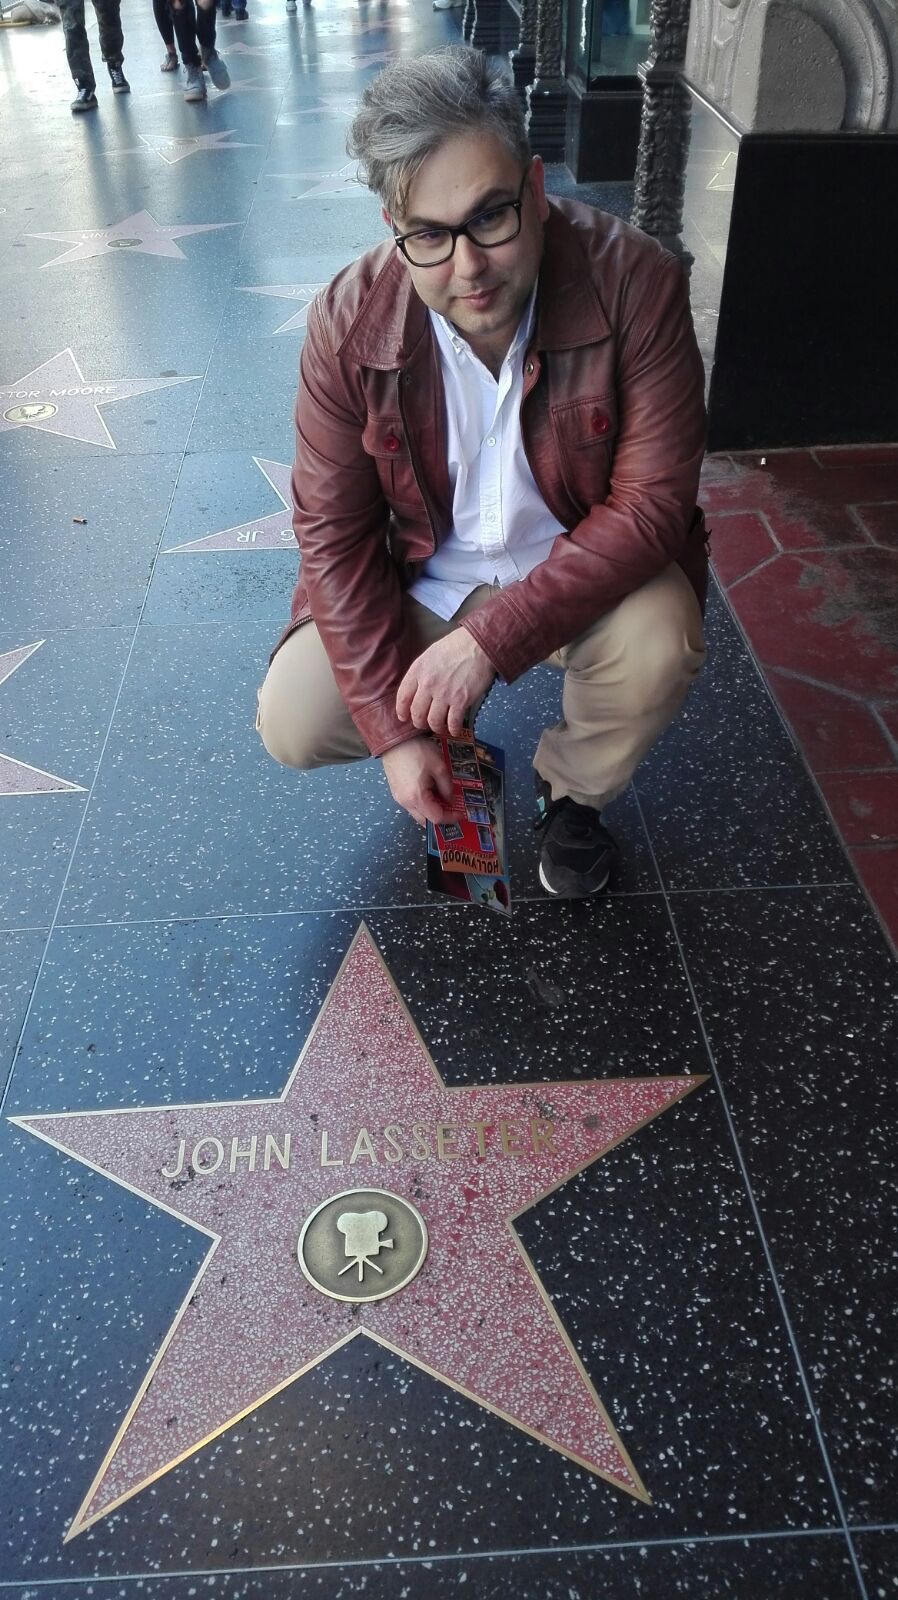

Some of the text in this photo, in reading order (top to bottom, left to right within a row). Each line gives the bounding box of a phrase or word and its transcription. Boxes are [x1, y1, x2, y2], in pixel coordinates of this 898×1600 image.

[49, 386, 118, 398] MOORE
[237, 530, 264, 542] JR
[443, 851, 499, 873] HOLLYWOOD
[162, 1119, 560, 1178] JOHN LASSETER
